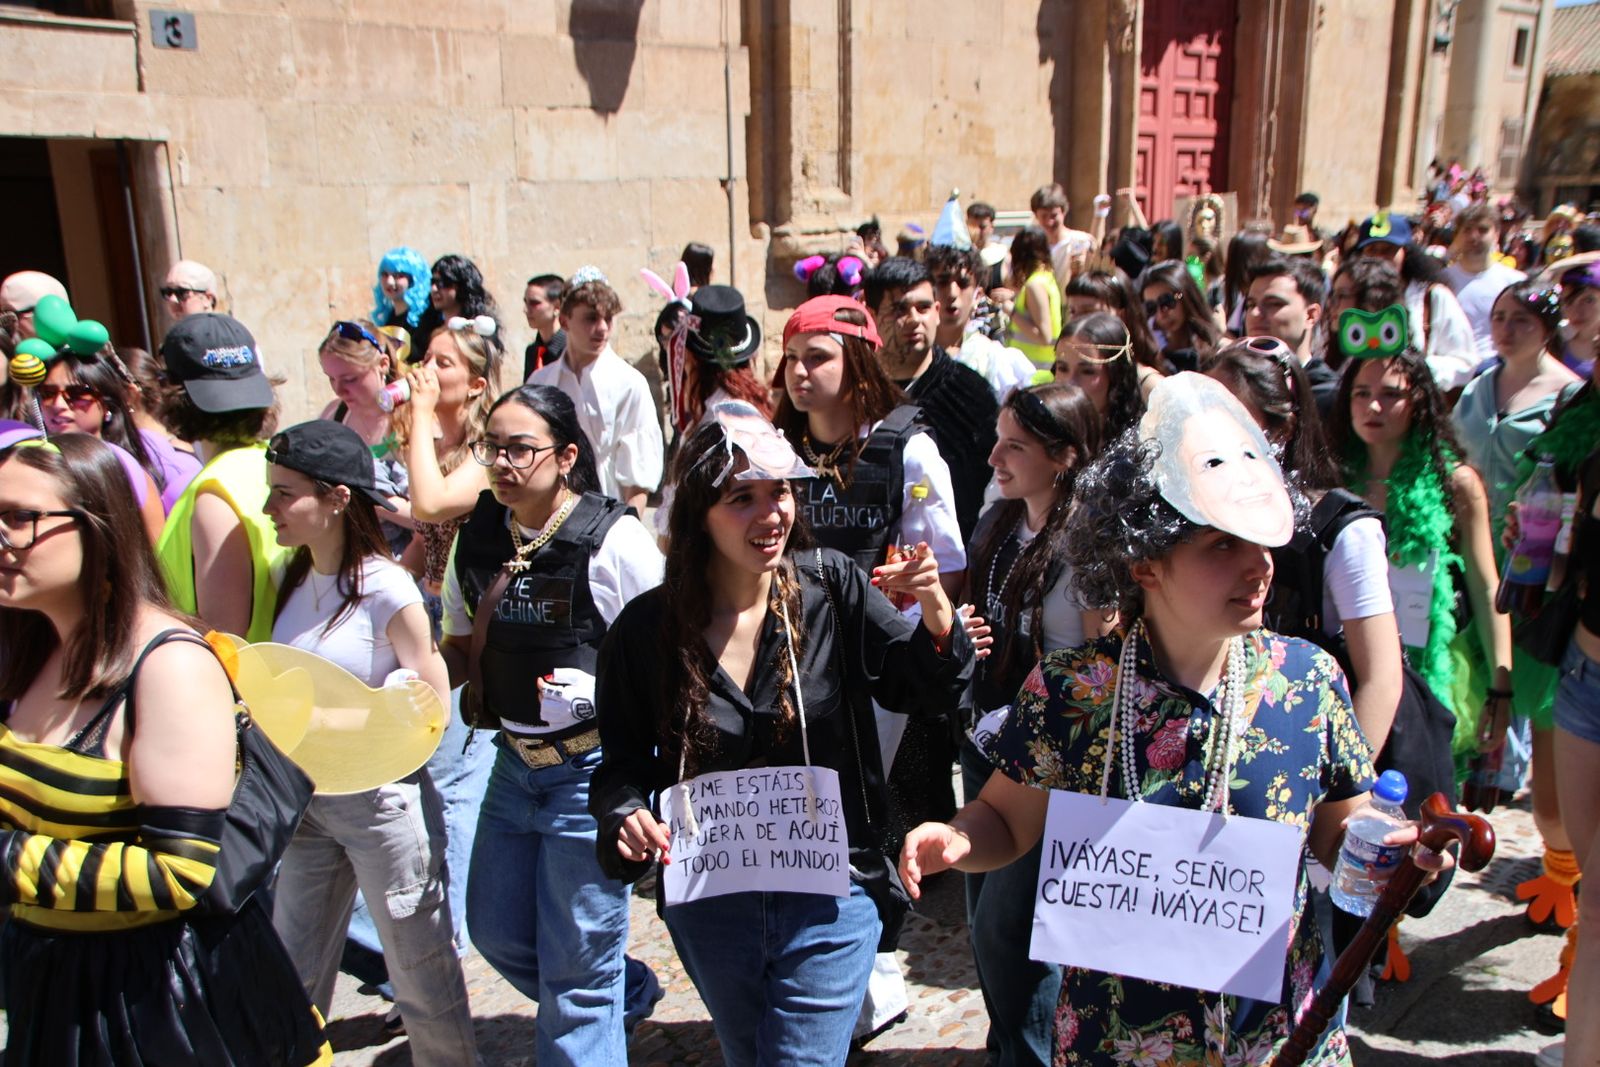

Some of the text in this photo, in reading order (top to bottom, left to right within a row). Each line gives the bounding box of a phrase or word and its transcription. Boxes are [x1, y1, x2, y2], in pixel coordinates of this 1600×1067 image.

[164, 16, 183, 48] 3
[808, 481, 838, 504] LA
[802, 504, 885, 528] FLUENCIA
[505, 577, 533, 599] HE
[690, 770, 805, 803] ¿ME ESTÁIS
[769, 796, 840, 819] HETERO?
[756, 822, 777, 841] DE
[788, 820, 840, 843] AQUÍ
[678, 849, 840, 877] TODO EL MUNDO!
[1050, 838, 1265, 897] ¡VÁYASE, SEÑOR
[1041, 878, 1266, 935] CUESTA! ¡VÁYASE!
